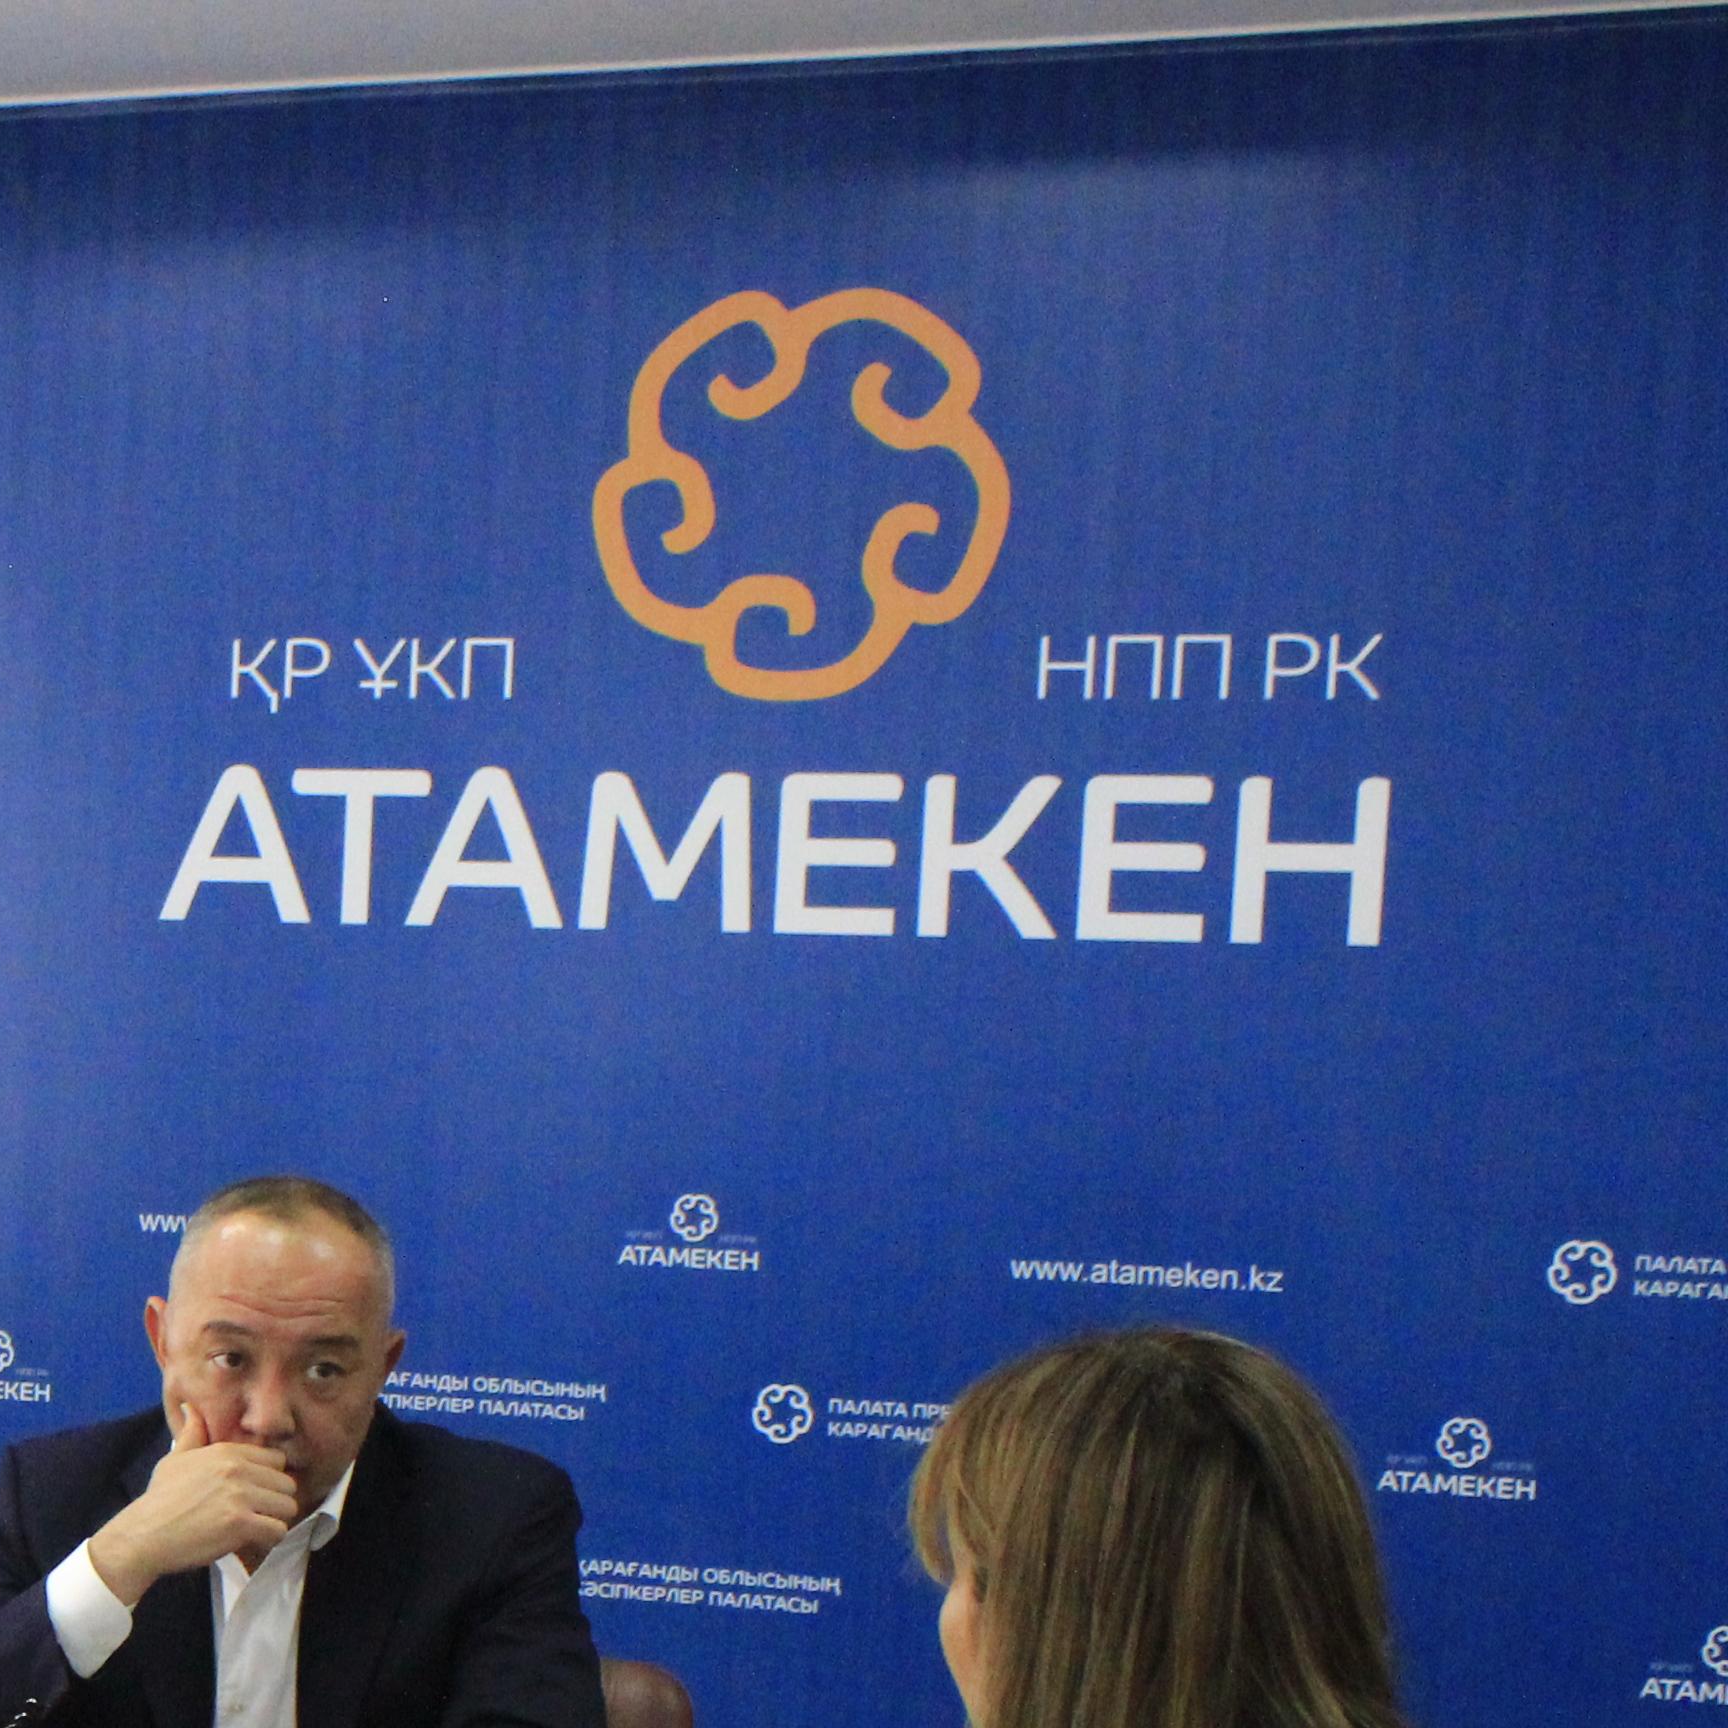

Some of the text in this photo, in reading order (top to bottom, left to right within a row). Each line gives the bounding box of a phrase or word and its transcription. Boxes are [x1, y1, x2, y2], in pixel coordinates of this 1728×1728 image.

[229, 637, 331, 712] ҚР
[1037, 633, 1383, 702] НПП РК
[159, 764, 1392, 947] АТАМЕКЕН
[618, 1245, 760, 1272] АТАМЕКЕН
[1634, 1254, 1727, 1274] ПАЛАТА
[1010, 1259, 1284, 1293] www.atameken.kz
[385, 1371, 469, 1392] АҒАНДЫ
[479, 1400, 585, 1421] ПАЛАТАСЫ
[828, 1398, 908, 1418] ПАЛАТА
[827, 1421, 935, 1445] КАРАГАНД
[1376, 1469, 1537, 1500] АТАМЕКЕН
[579, 1581, 819, 1614] ӘСІПКЕРЛЕР ПАЛАТАСЫ
[1639, 1677, 1728, 1705] АТАМ
